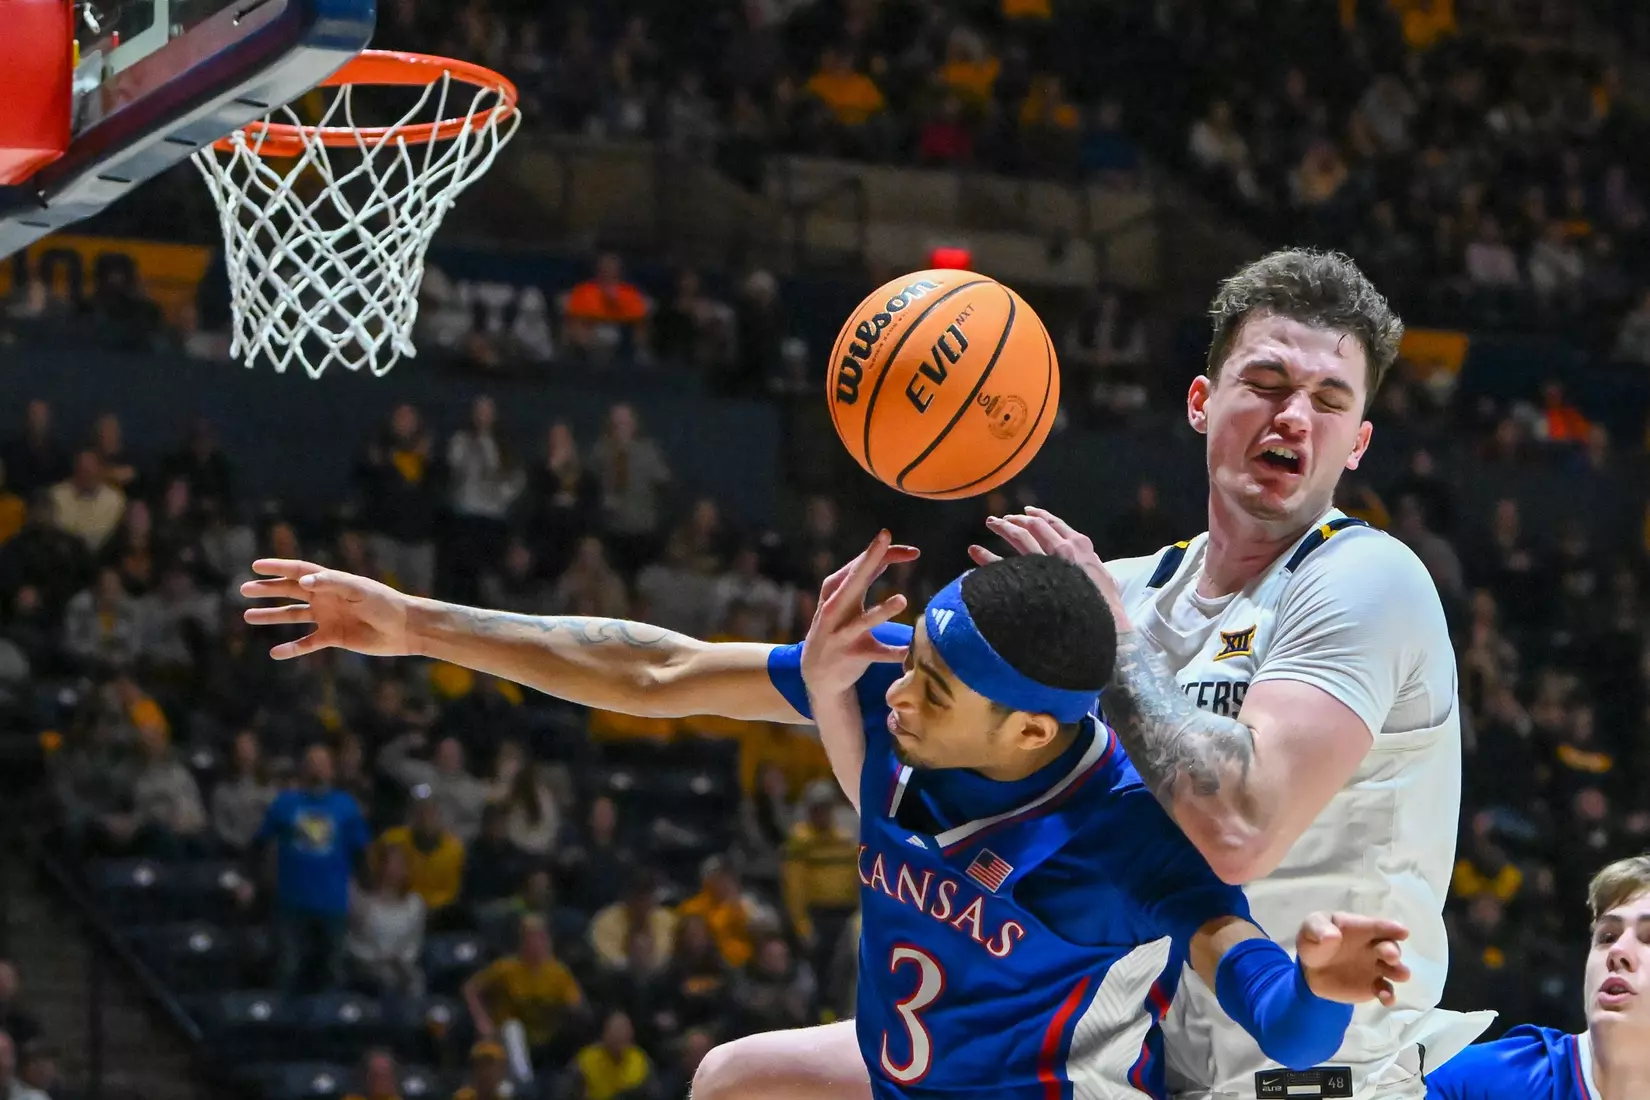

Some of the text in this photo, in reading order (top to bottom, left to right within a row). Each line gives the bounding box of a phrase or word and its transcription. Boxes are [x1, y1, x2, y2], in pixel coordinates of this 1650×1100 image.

[905, 302, 975, 414] EVO NXT
[880, 944, 946, 1085] 3
[1328, 1077, 1344, 1089] 48
